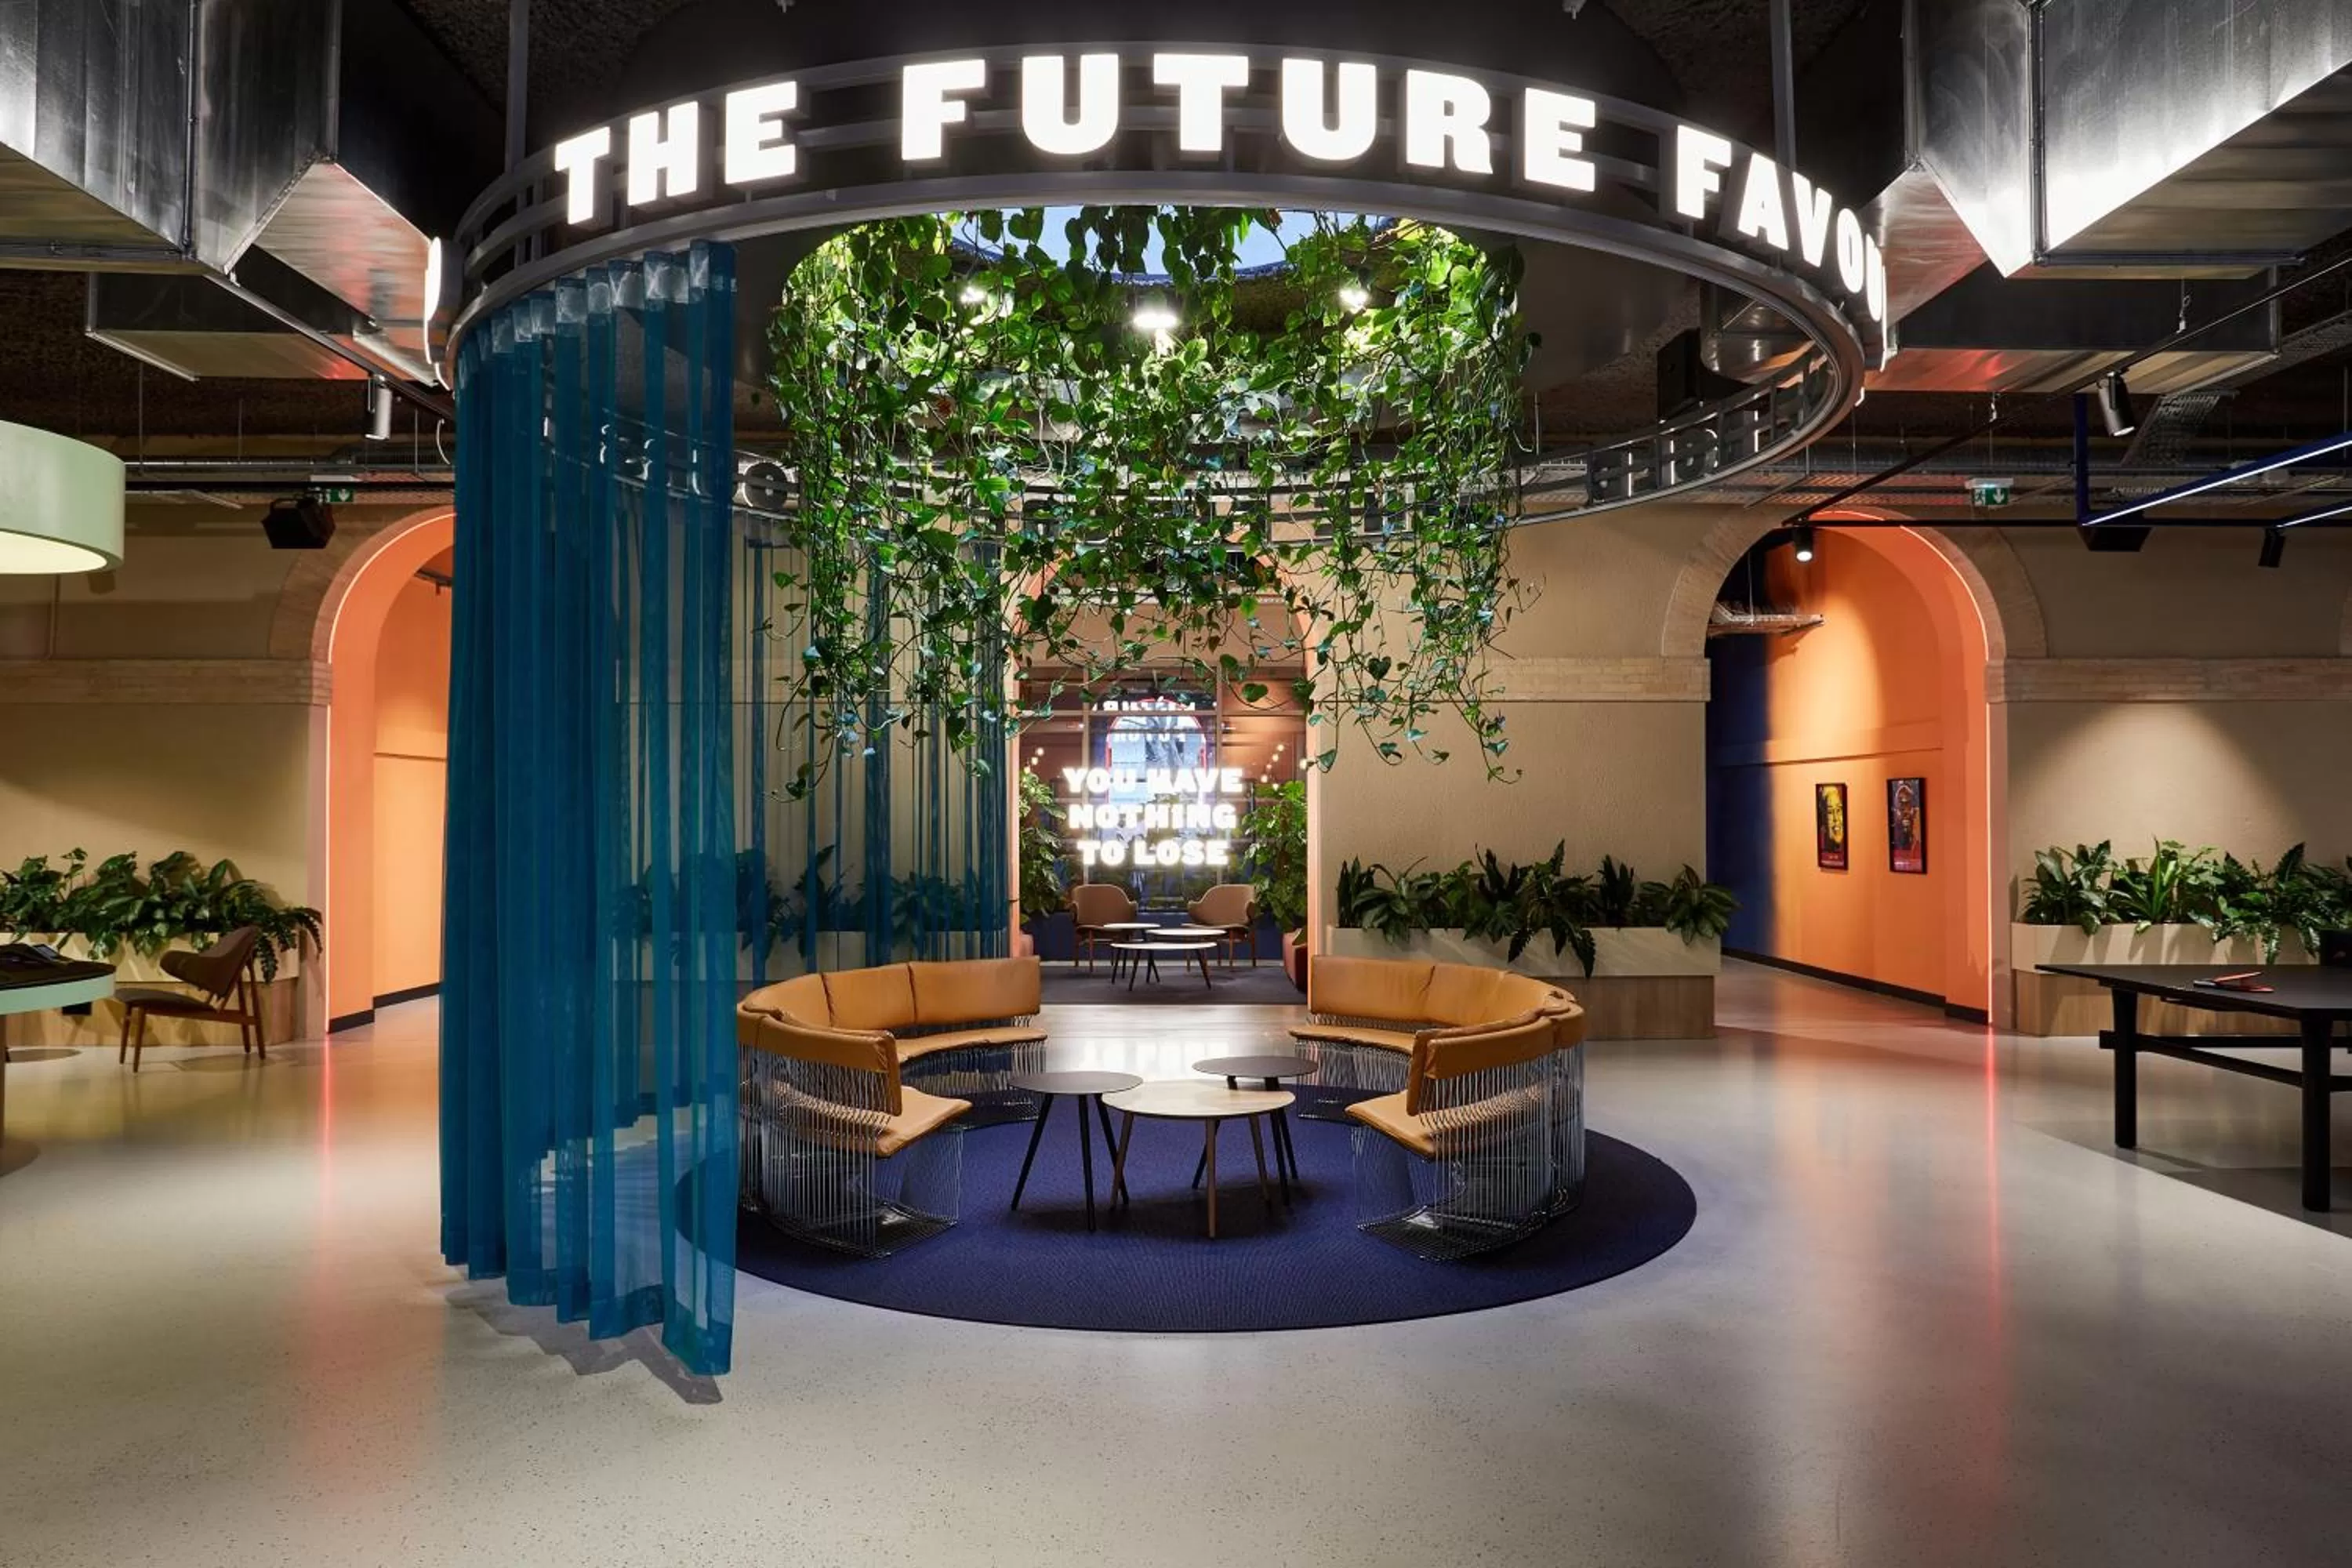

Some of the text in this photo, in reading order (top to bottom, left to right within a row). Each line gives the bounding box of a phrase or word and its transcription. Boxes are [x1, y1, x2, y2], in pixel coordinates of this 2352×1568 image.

[554, 81, 797, 225] THE
[902, 53, 1595, 191] FUTURE
[1062, 768, 1243, 793] YOU HAVE
[1069, 804, 1236, 829] NOTHING
[1076, 840, 1229, 866] TO LOSE
